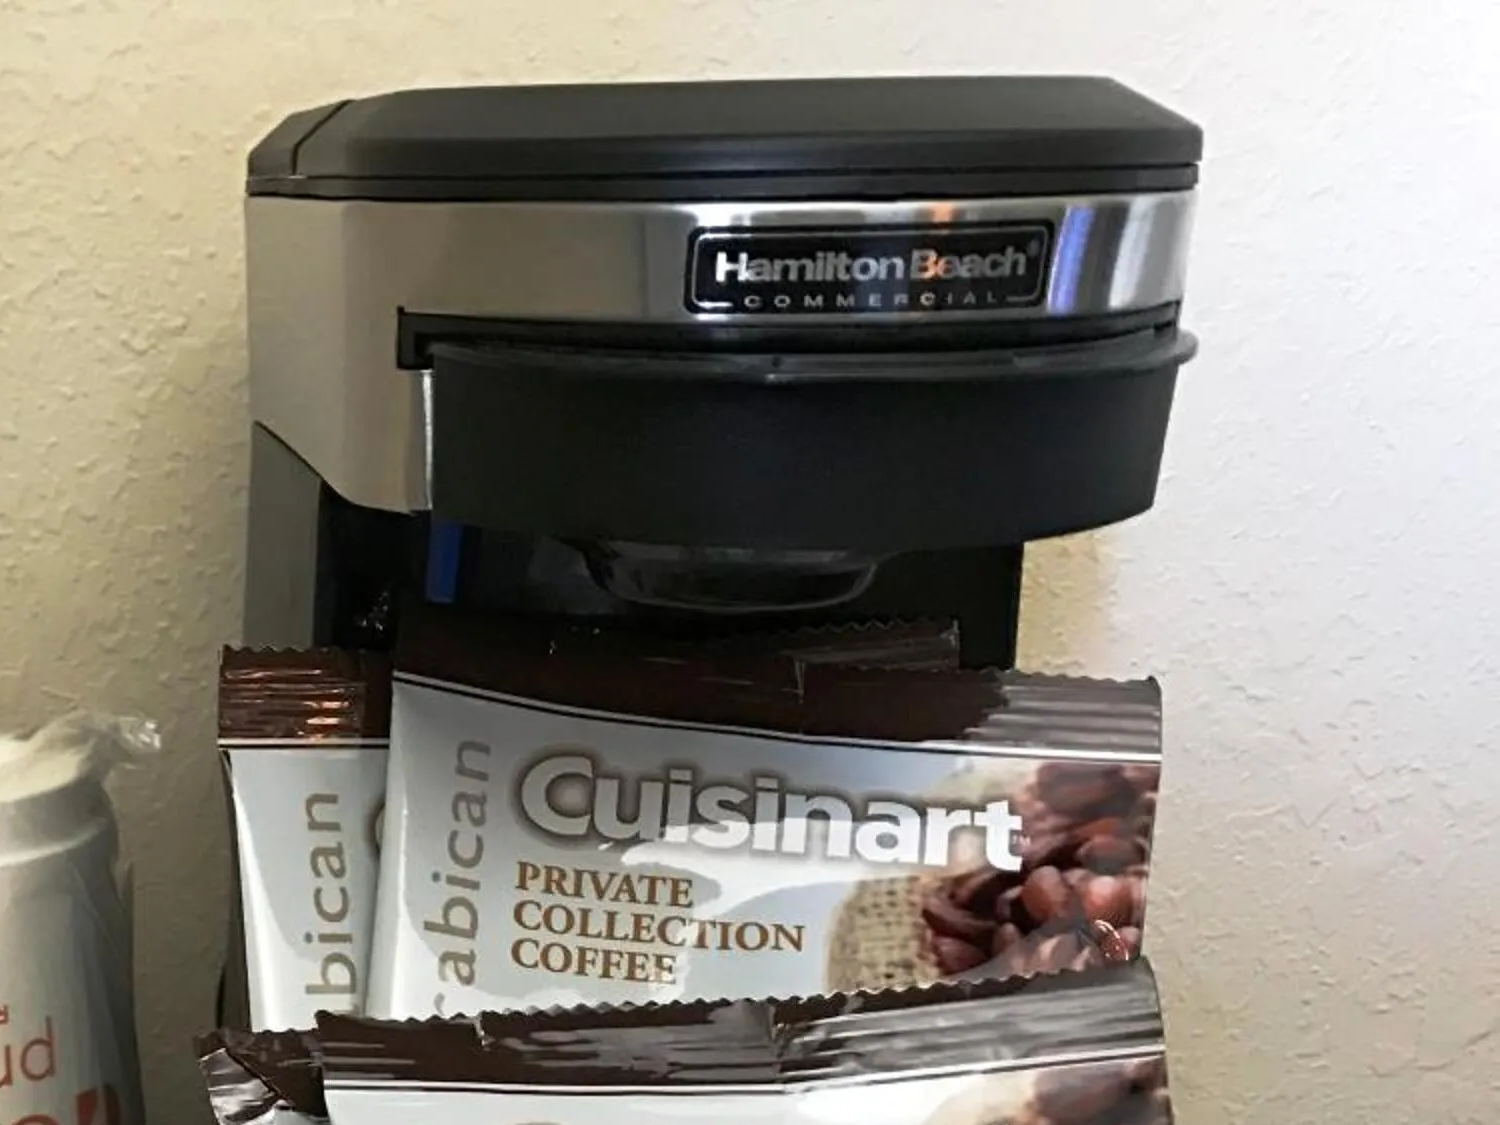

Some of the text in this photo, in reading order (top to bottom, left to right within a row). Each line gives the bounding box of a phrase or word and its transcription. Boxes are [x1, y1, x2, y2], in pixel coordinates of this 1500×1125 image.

[714, 246, 1028, 284] Hamilton Beach
[743, 290, 999, 309] COMMERCIAL
[520, 754, 1023, 872] Cuisinart
[303, 792, 358, 1005] bican
[423, 739, 492, 1013] abican
[514, 860, 694, 909] PRIVATE
[511, 899, 806, 953] COLLECTION
[510, 937, 678, 987] COFFEE
